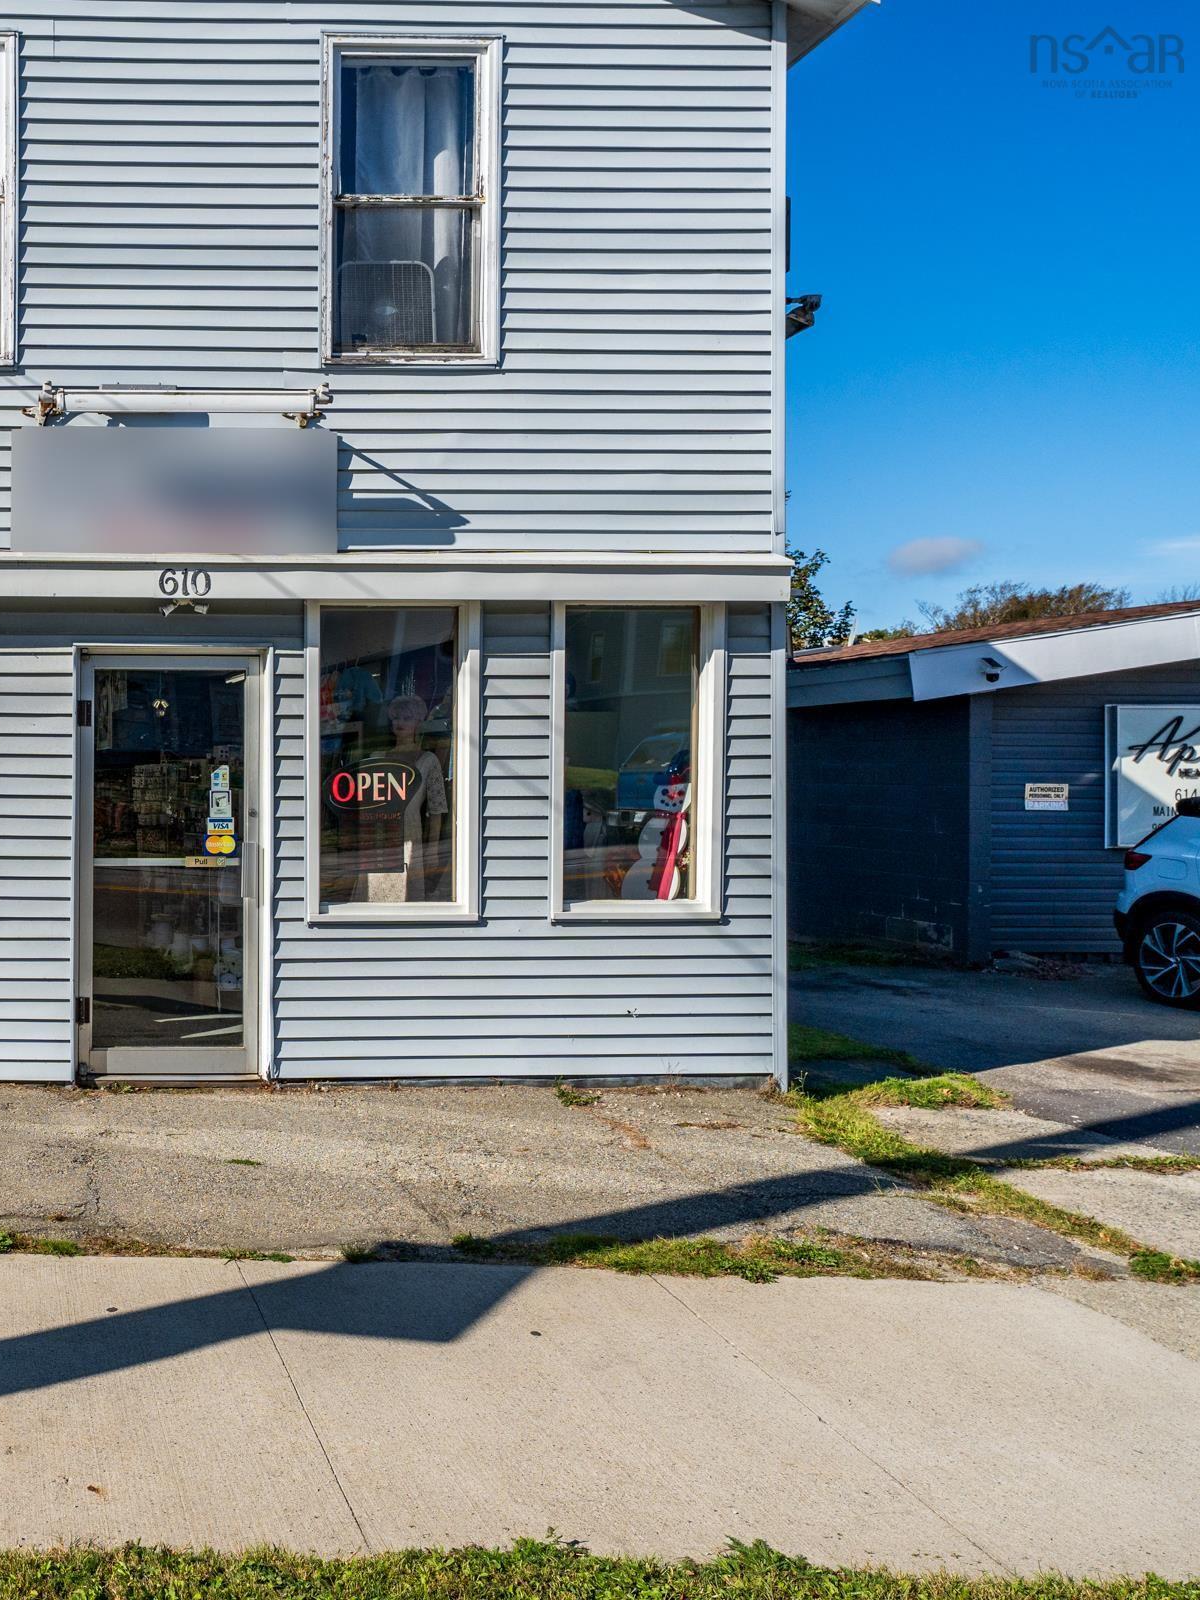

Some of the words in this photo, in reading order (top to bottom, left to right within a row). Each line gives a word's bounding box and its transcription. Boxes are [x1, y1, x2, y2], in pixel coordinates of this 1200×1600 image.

[159, 568, 211, 596] 610
[332, 772, 406, 802] OPEN
[1029, 801, 1065, 809] PARKING
